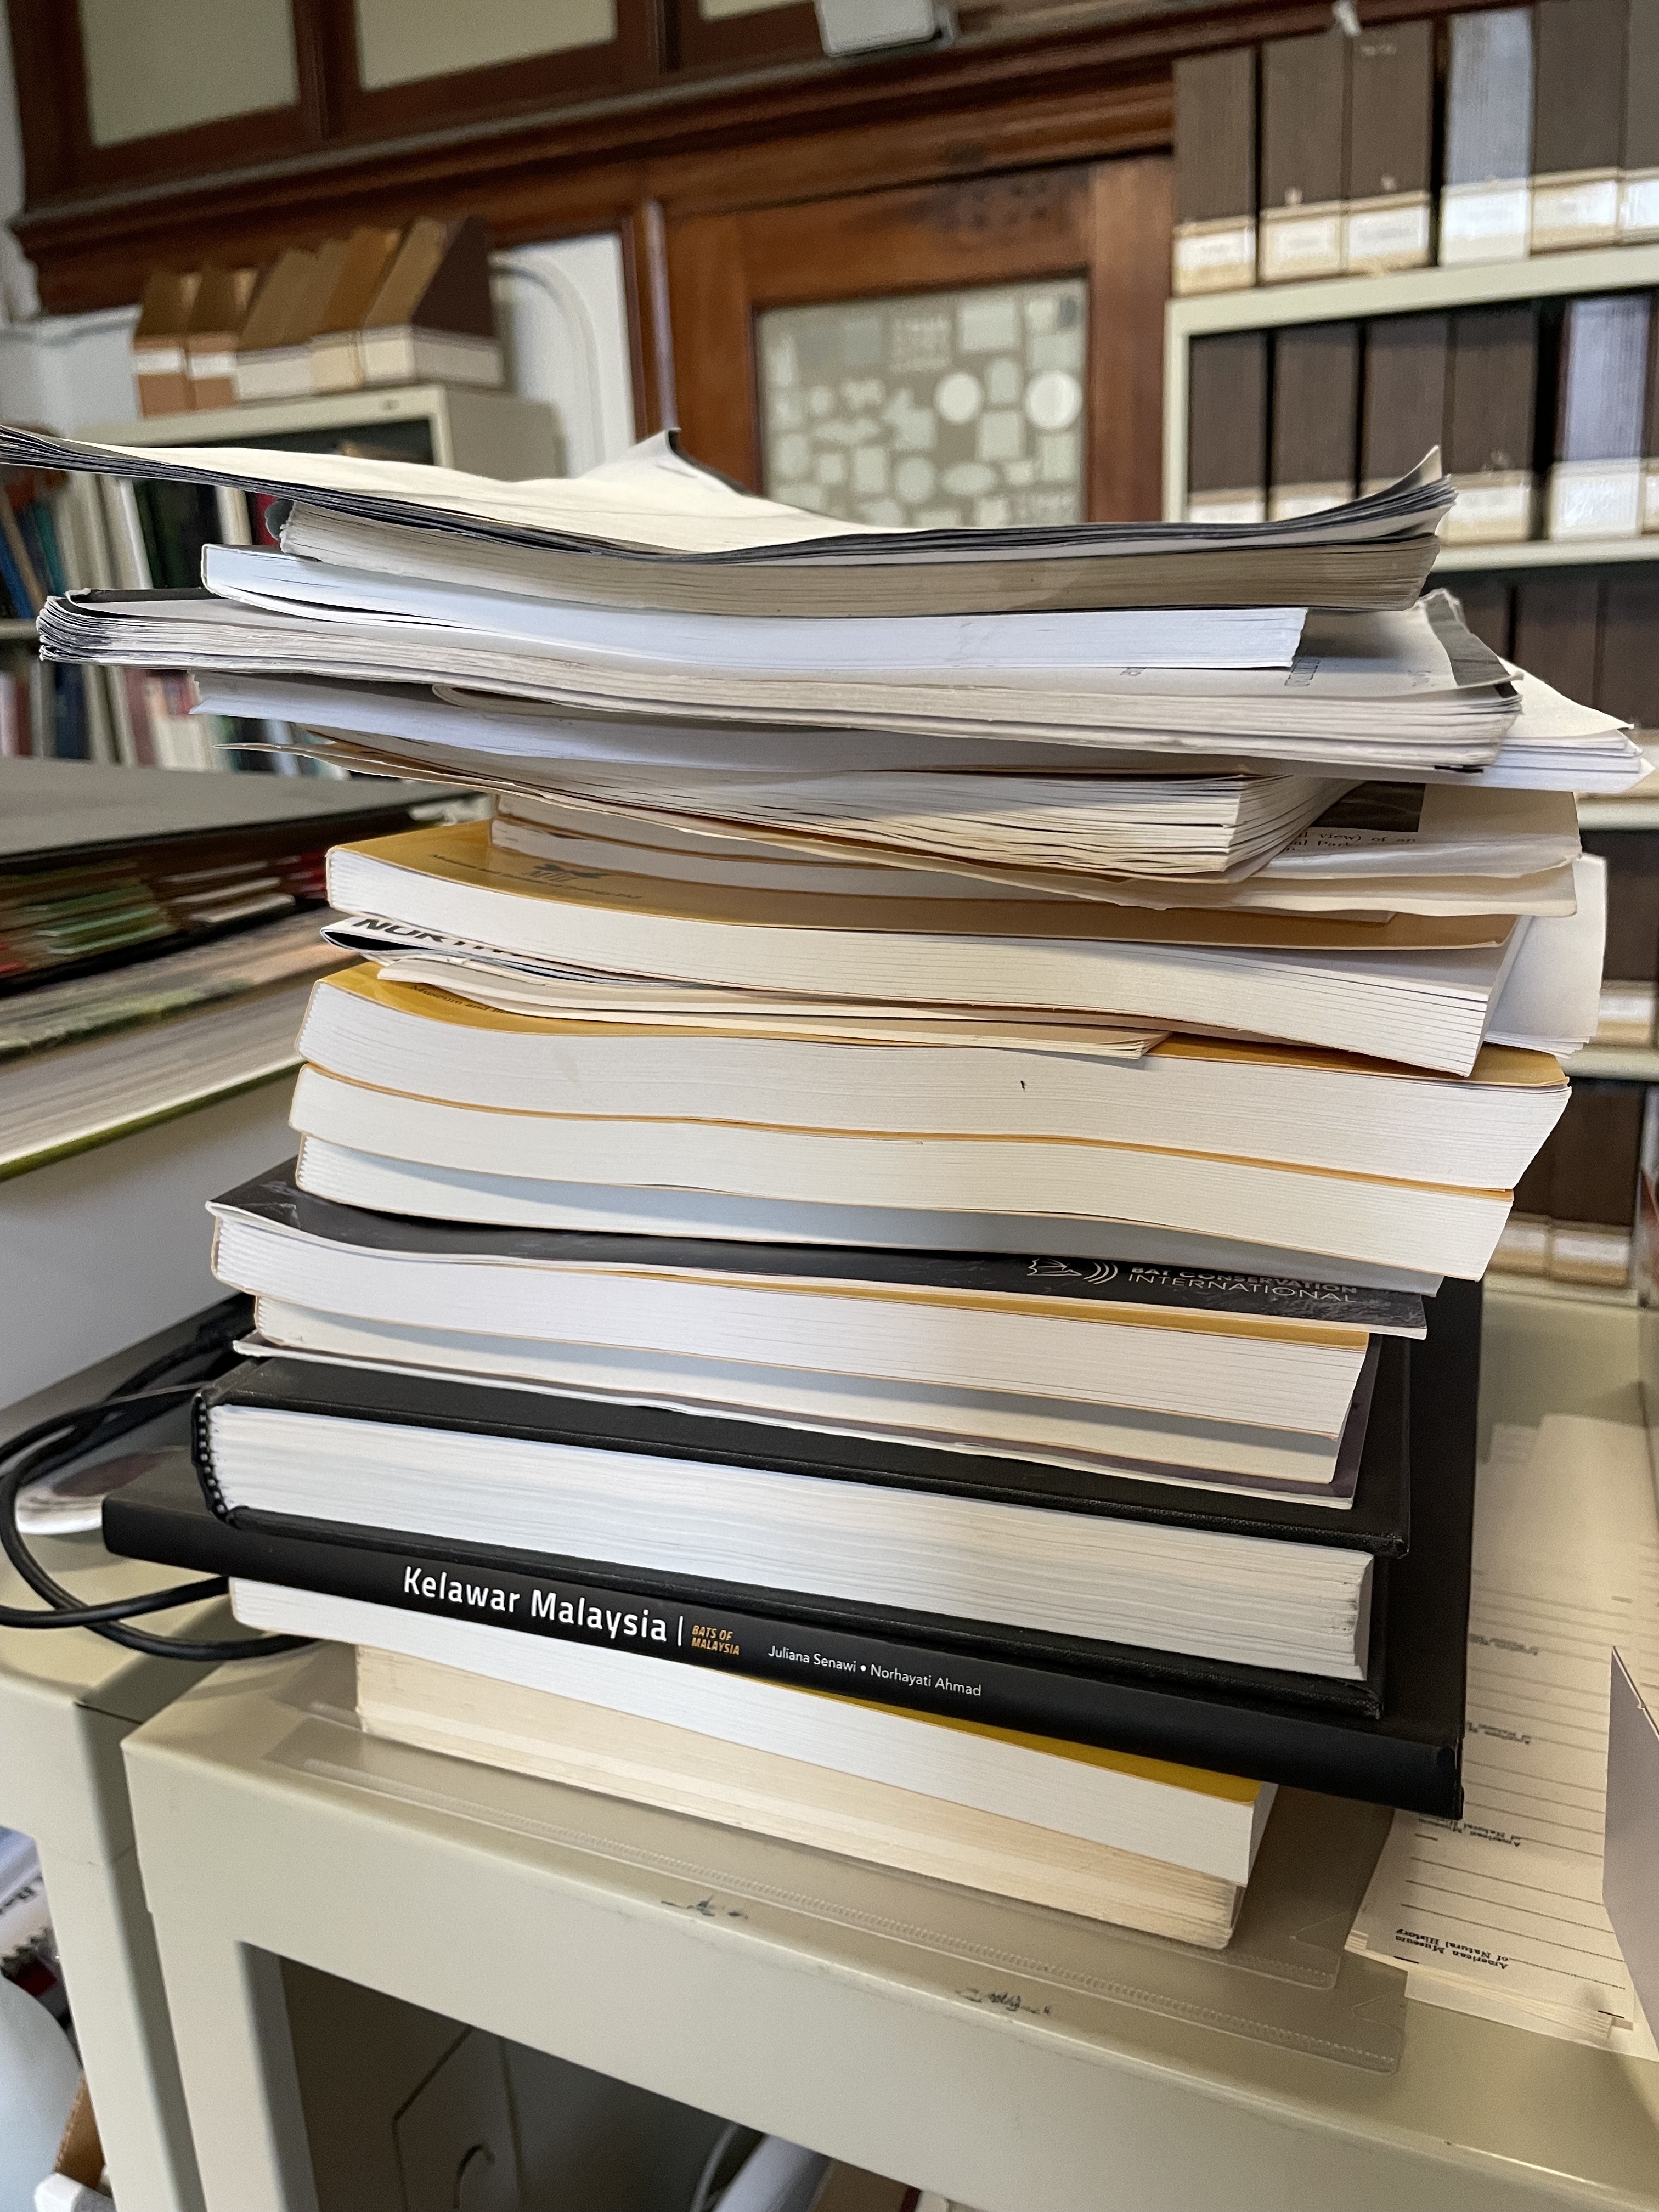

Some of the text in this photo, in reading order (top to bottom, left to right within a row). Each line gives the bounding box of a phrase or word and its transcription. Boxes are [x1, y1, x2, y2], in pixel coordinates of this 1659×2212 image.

[1128, 1273, 1357, 1304] INTERNATIONAL
[1131, 1267, 1357, 1294] BAT CONSERVATION
[403, 1566, 667, 1641] Kelawar Malaysia
[691, 1624, 734, 1641] BATS OF
[691, 1637, 740, 1655] MALAYSIA
[768, 1645, 982, 1696] Juliana Senawi Norhayati Ahmad
[1396, 1928, 1440, 1945] History
[1445, 1941, 1491, 1959] Natural
[1395, 1935, 1509, 1970] American Museum
